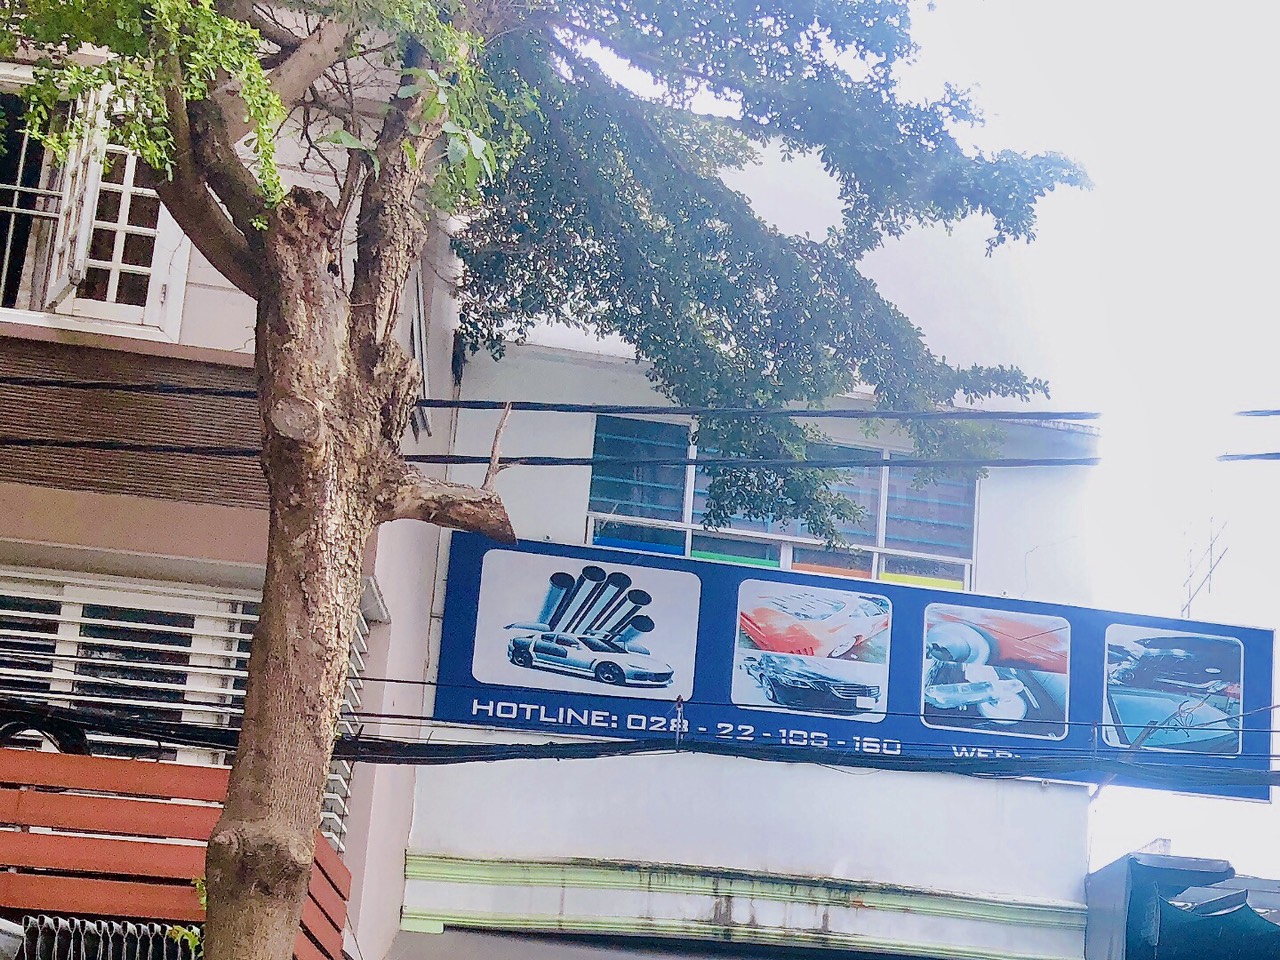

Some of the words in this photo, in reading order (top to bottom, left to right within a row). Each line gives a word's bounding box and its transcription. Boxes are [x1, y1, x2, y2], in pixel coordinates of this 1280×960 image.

[471, 699, 618, 729] HOTLINE:
[626, 713, 689, 733] 028
[715, 722, 755, 741] 22
[852, 736, 902, 756] 160
